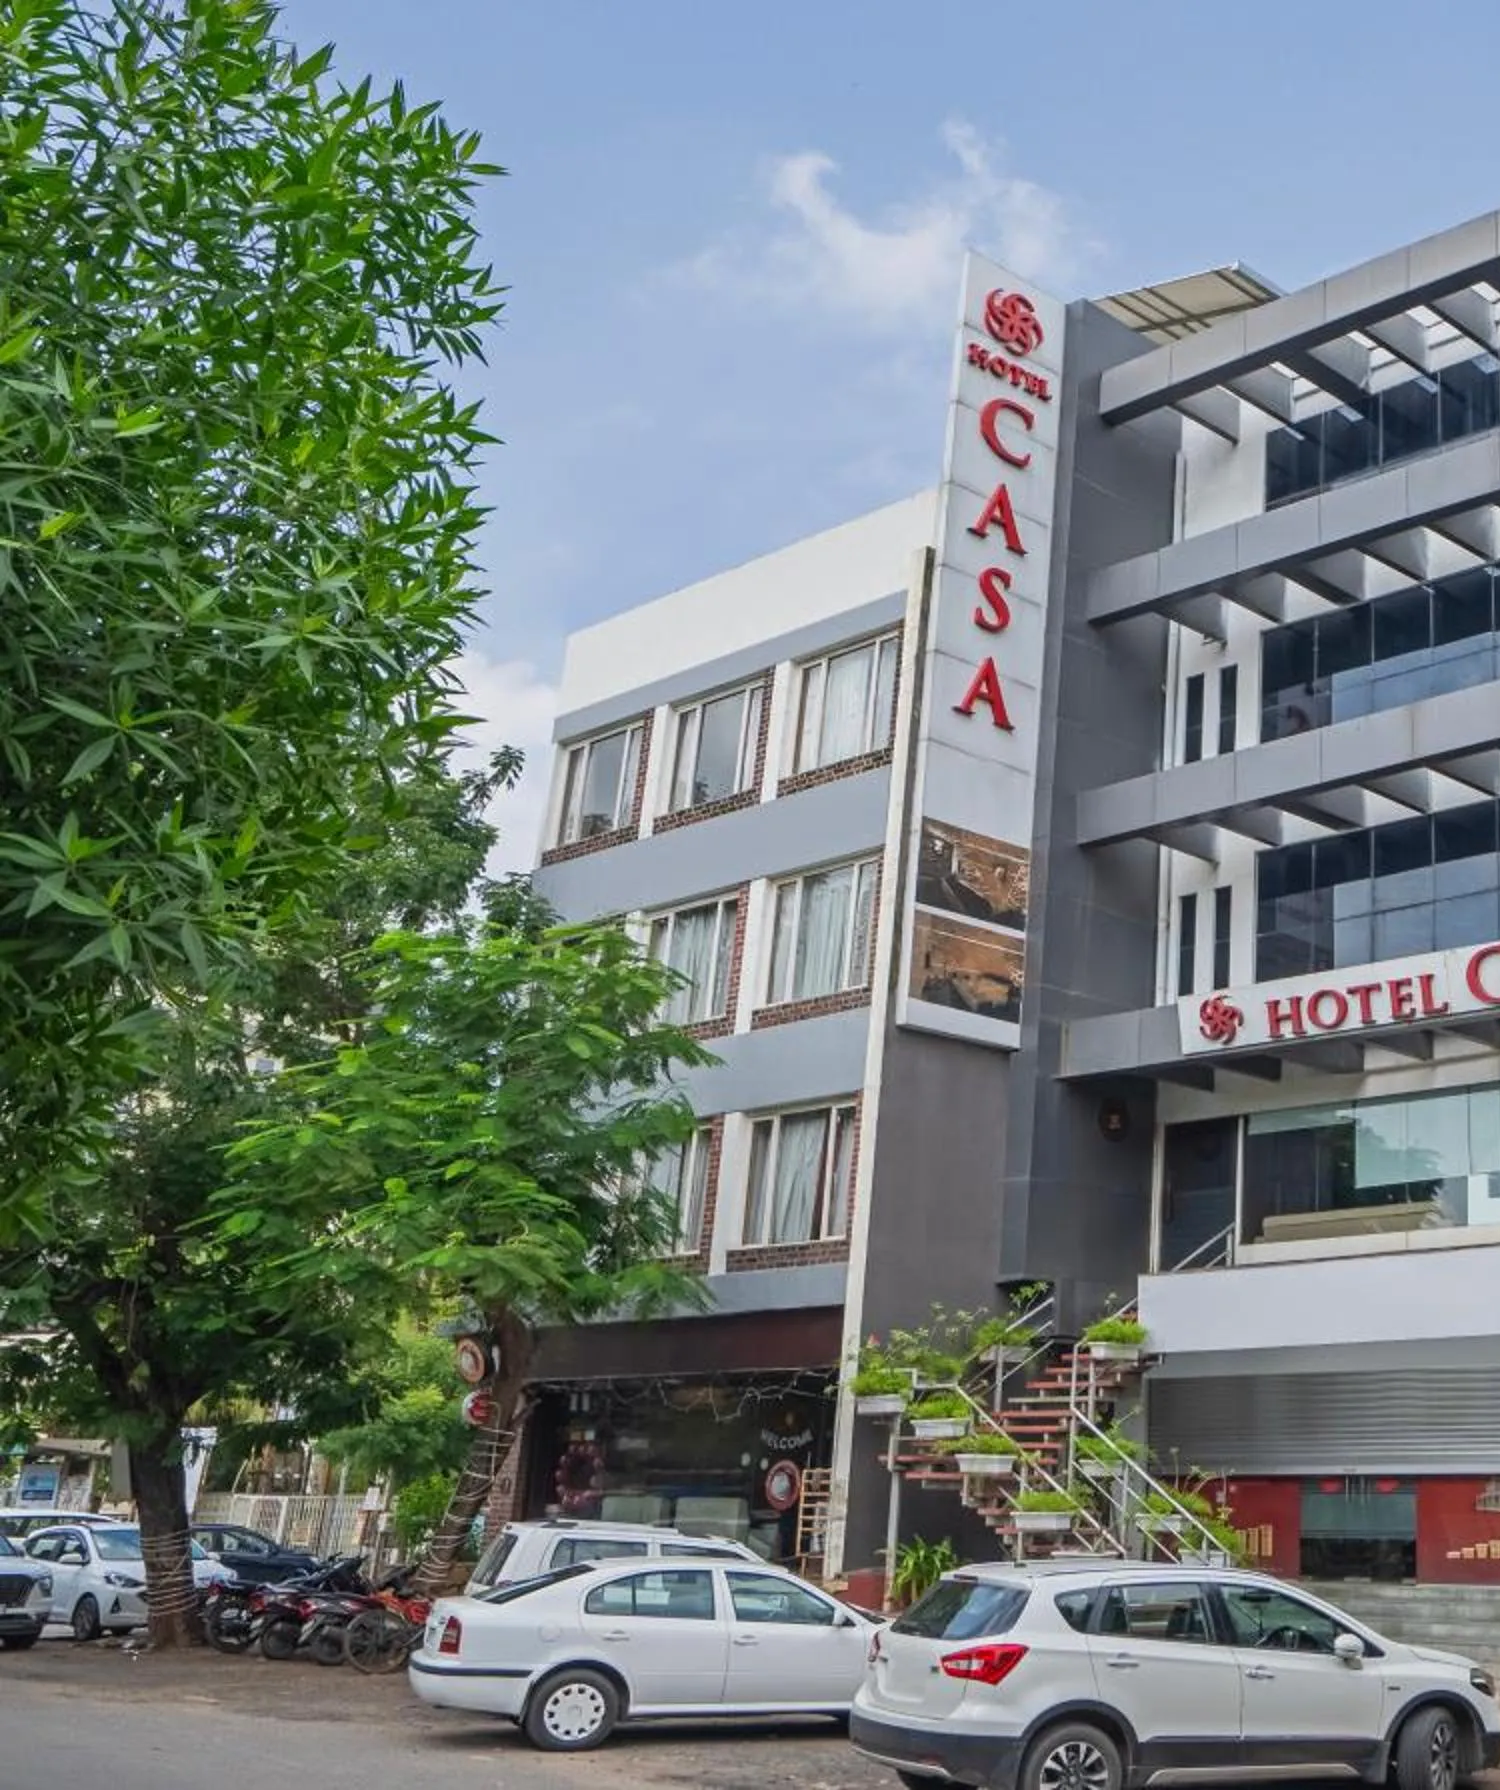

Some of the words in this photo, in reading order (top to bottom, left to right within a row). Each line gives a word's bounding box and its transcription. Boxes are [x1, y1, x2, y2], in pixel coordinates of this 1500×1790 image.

[967, 343, 1053, 402] HOTEL
[952, 398, 1034, 731] CASA
[1264, 973, 1450, 1039] HOTEL
